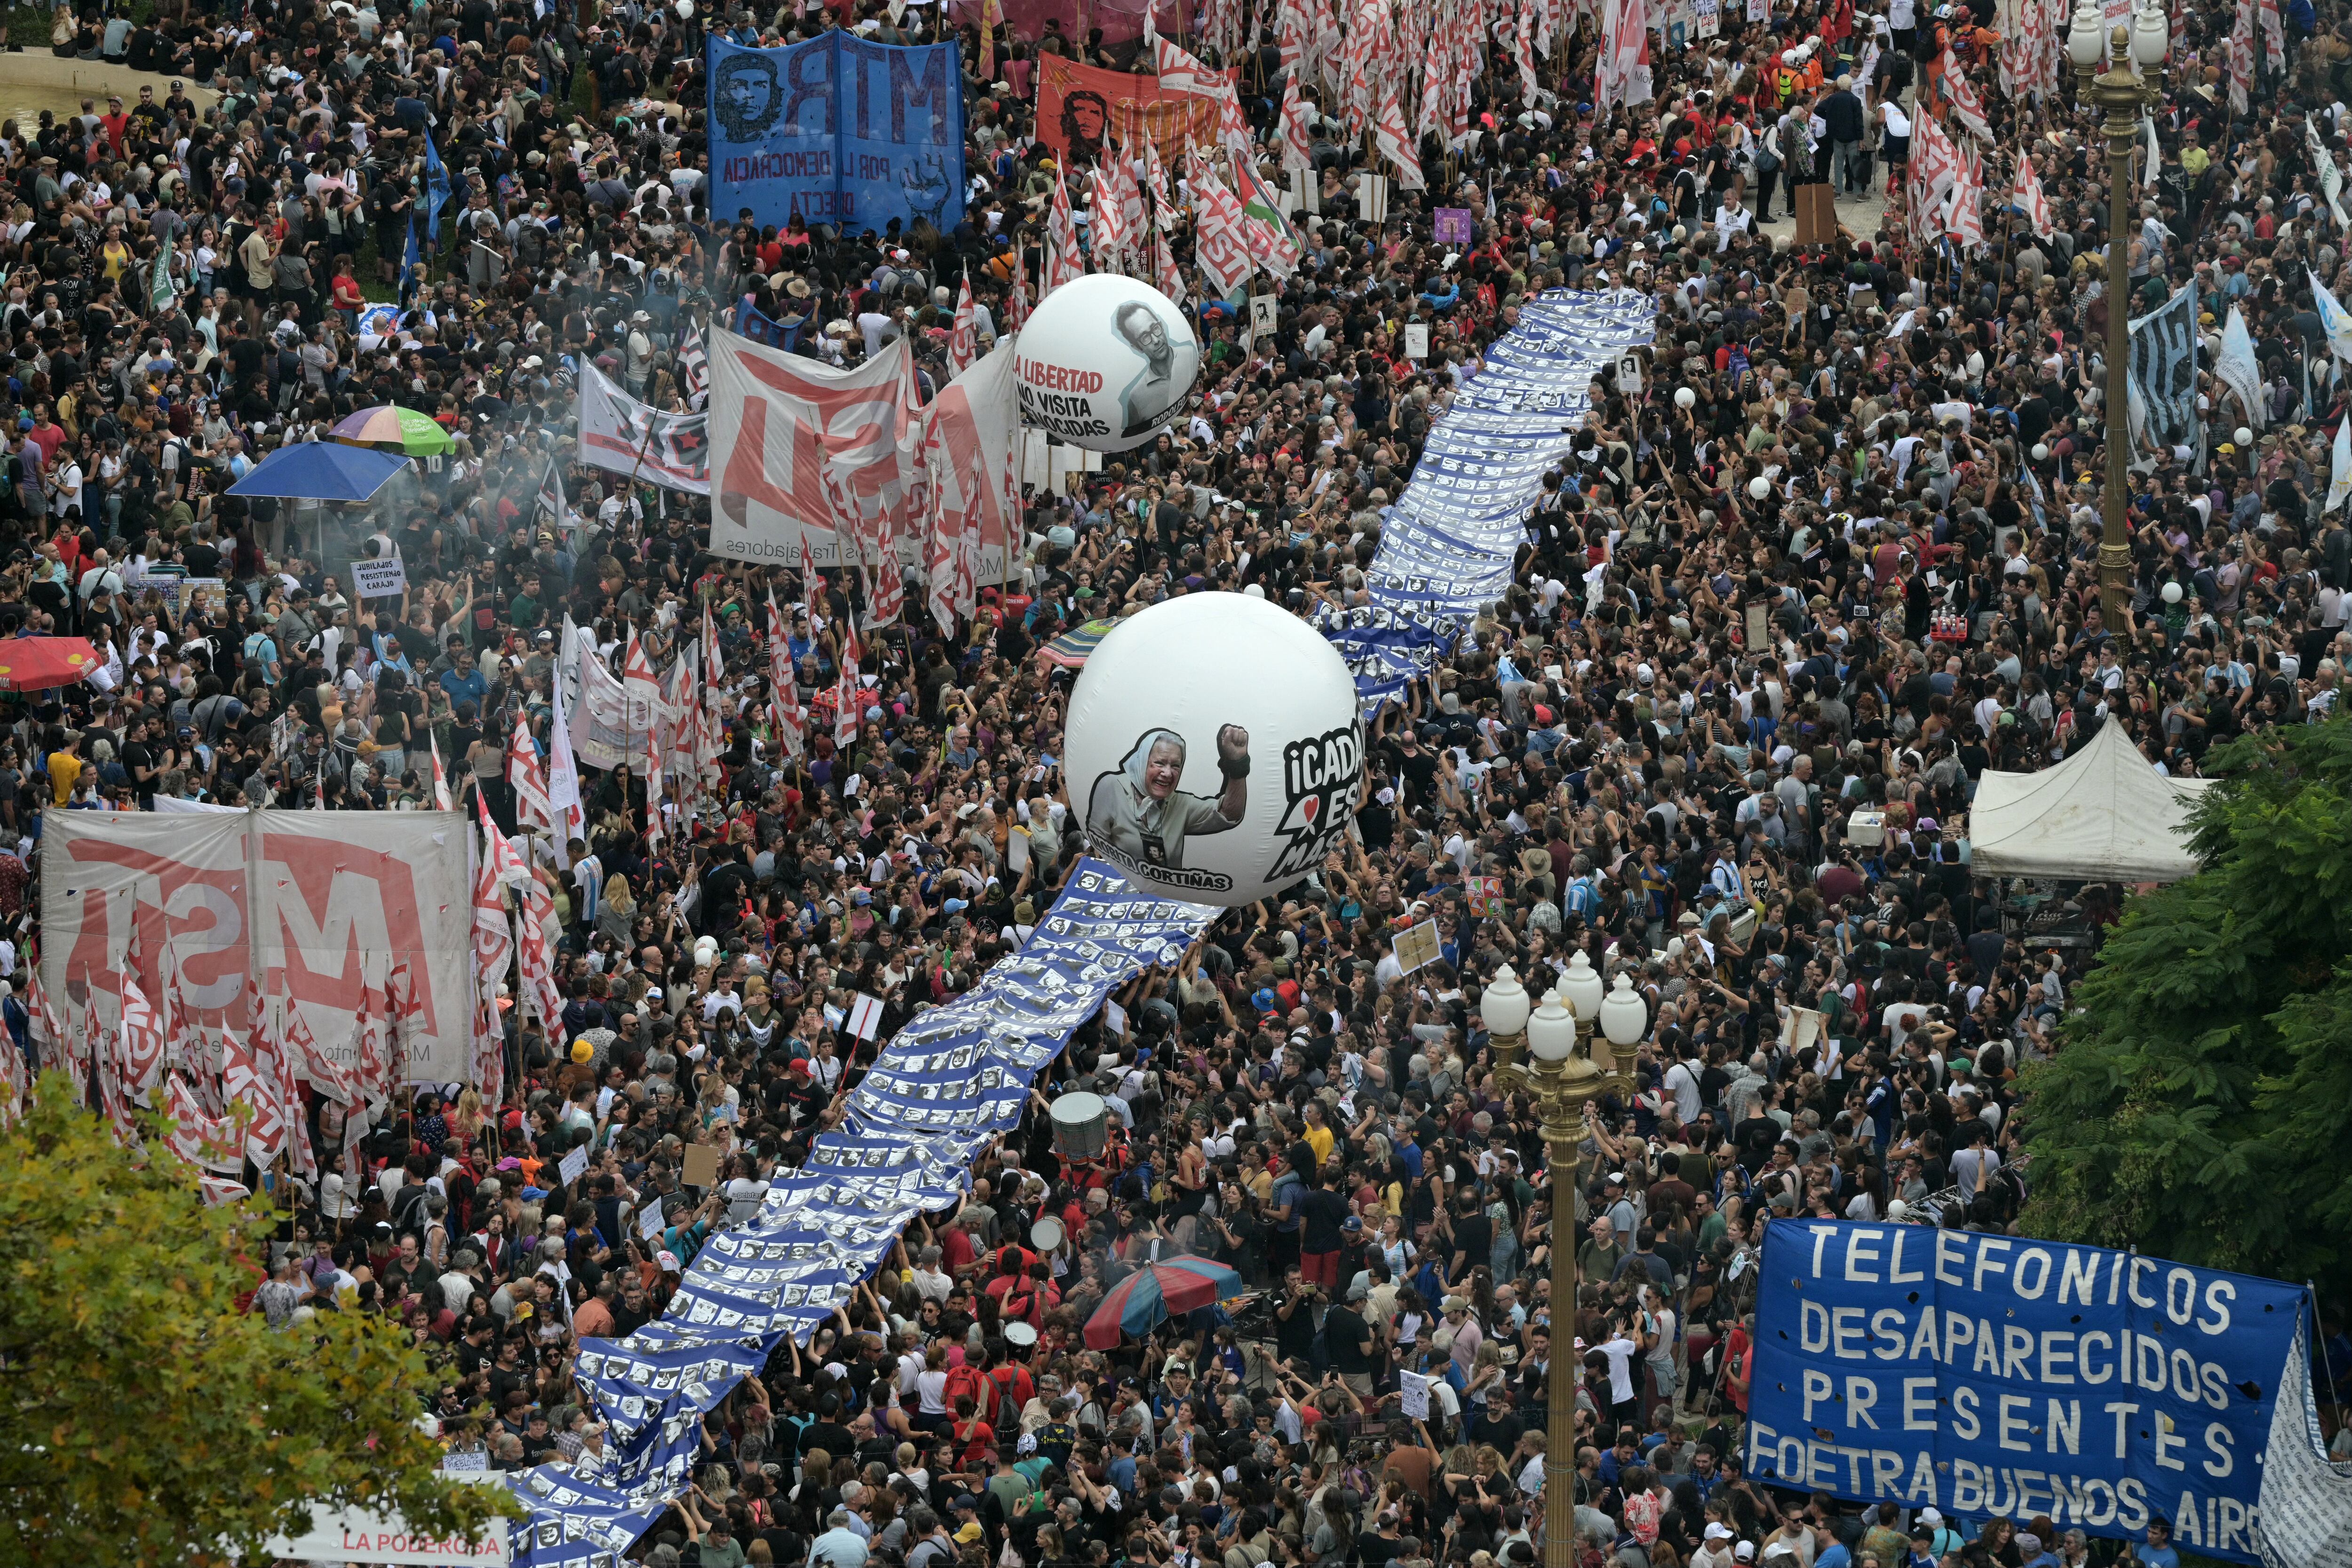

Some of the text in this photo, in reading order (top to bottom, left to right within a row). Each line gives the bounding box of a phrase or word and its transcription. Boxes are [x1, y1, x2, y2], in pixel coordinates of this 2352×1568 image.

[1025, 360, 1103, 394] LIBERTAD
[1017, 382, 1092, 418] NO VISITA
[1156, 396, 1191, 428] RODOLFO
[1026, 404, 1110, 437] ENOCIDAS
[425, 454, 443, 473] 10
[367, 580, 394, 589] CARAJO
[1091, 833, 1226, 889] NORITA CORTIÑAS
[1279, 829, 1343, 871] MÁS
[256, 1065, 275, 1081] ocialista
[1809, 1225, 2237, 1336] TELEFONICOS
[1800, 1298, 2230, 1410] DESAPARECIDOS
[1803, 1369, 2234, 1478] PRESENTES
[446, 1460, 471, 1468] PUEBLO
[1748, 1419, 1937, 1503] FOETRA
[1953, 1457, 2150, 1531] BUENOS
[343, 1532, 371, 1552] LA
